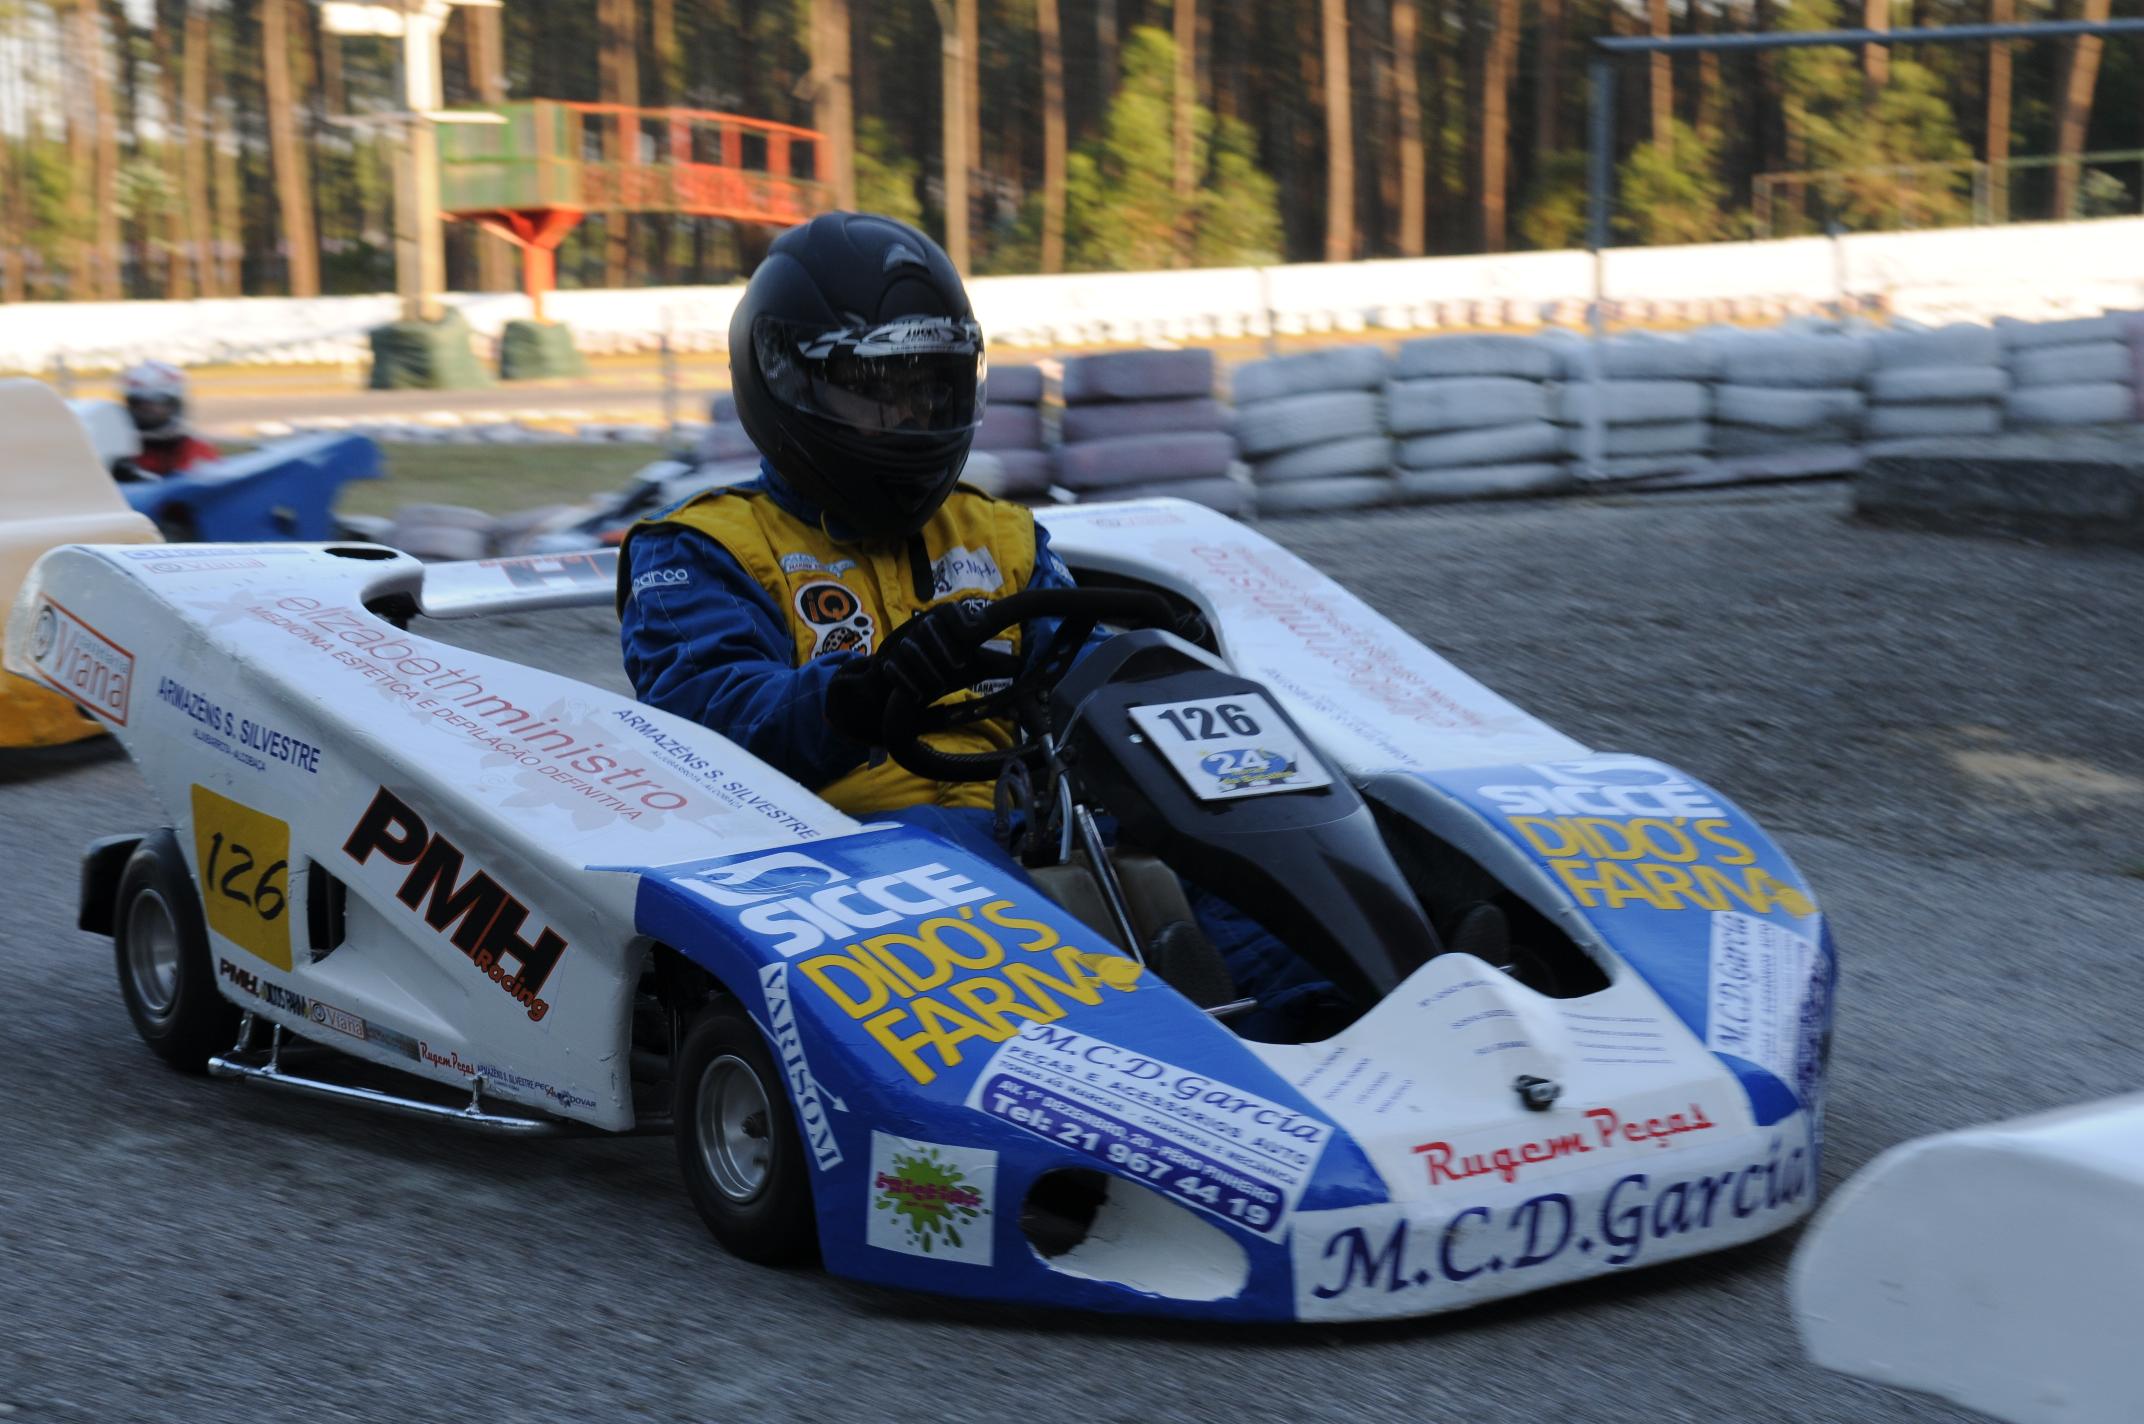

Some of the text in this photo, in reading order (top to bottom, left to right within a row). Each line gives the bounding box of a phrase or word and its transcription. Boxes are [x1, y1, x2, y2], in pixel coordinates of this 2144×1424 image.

[632, 569, 688, 592] parco
[54, 620, 125, 709] Viana
[276, 595, 688, 811] elizabethministro
[224, 711, 236, 739] S.
[240, 719, 321, 775] SILVESTRE
[249, 605, 330, 653] MEDICINA
[417, 697, 435, 711] E
[431, 707, 541, 767] DEPILAÇÃO
[538, 763, 643, 822] DEFINITIVA
[1158, 703, 1261, 742] 126
[1206, 749, 1271, 775] 24
[1478, 784, 1726, 818] SICCE
[704, 769, 724, 782] S.
[723, 782, 821, 840] SILVESTRE
[1506, 816, 1756, 866] DIDO'S
[206, 832, 289, 921] 126
[343, 785, 568, 998] PMH
[739, 861, 997, 959] SICCE
[1548, 858, 1773, 915] FARM
[474, 948, 549, 1022] Racing
[798, 900, 1060, 1020] DIDO'S
[325, 1009, 364, 1036] Viana
[862, 945, 1104, 1086] FARM
[419, 1040, 452, 1069] Rugem
[450, 1051, 475, 1077] Peças
[1007, 1046, 1076, 1073] PEÇAS
[1085, 1072, 1100, 1082] E
[1251, 1137, 1309, 1165] AUTO
[1412, 1103, 1719, 1186] Rugem Peças
[992, 1092, 1272, 1226] Tel: 21 967 44 19
